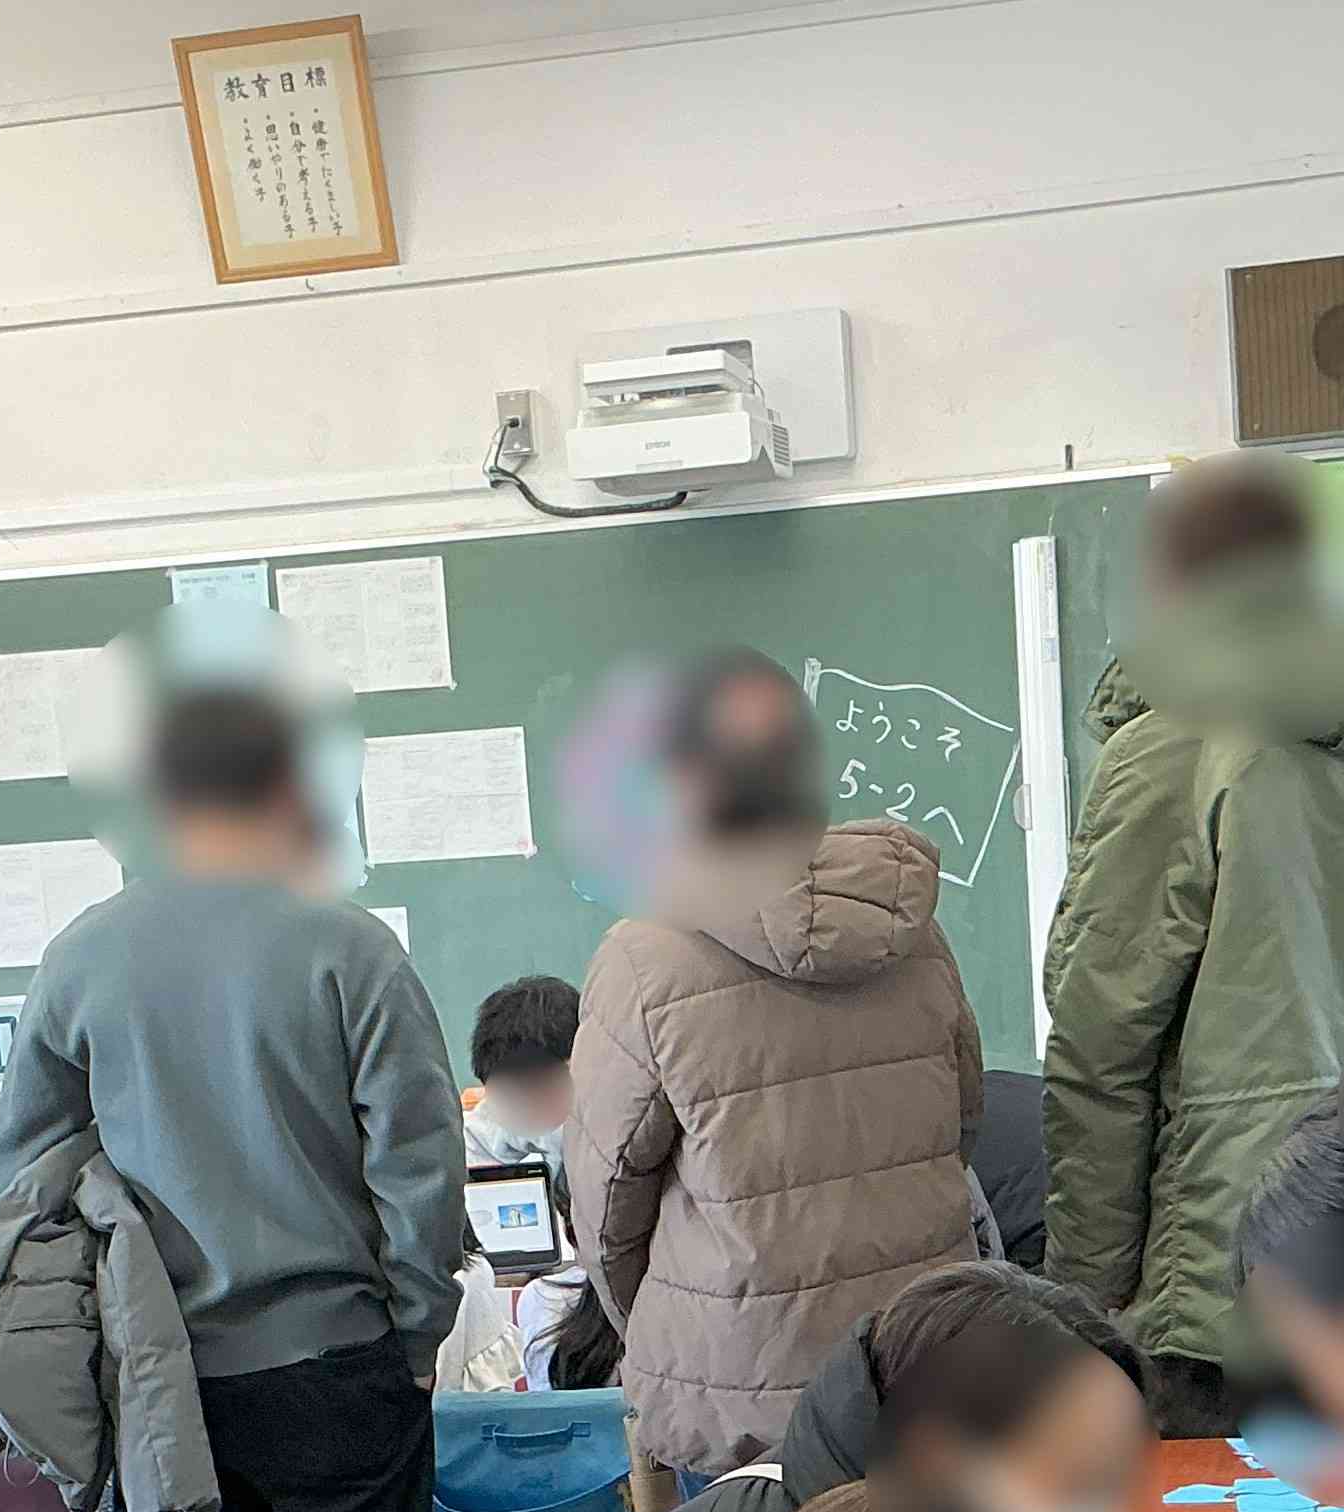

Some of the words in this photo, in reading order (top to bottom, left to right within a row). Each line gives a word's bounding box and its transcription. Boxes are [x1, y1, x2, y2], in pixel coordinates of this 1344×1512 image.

[223, 66, 328, 102] 教育目標
[835, 699, 962, 762] ようこそ
